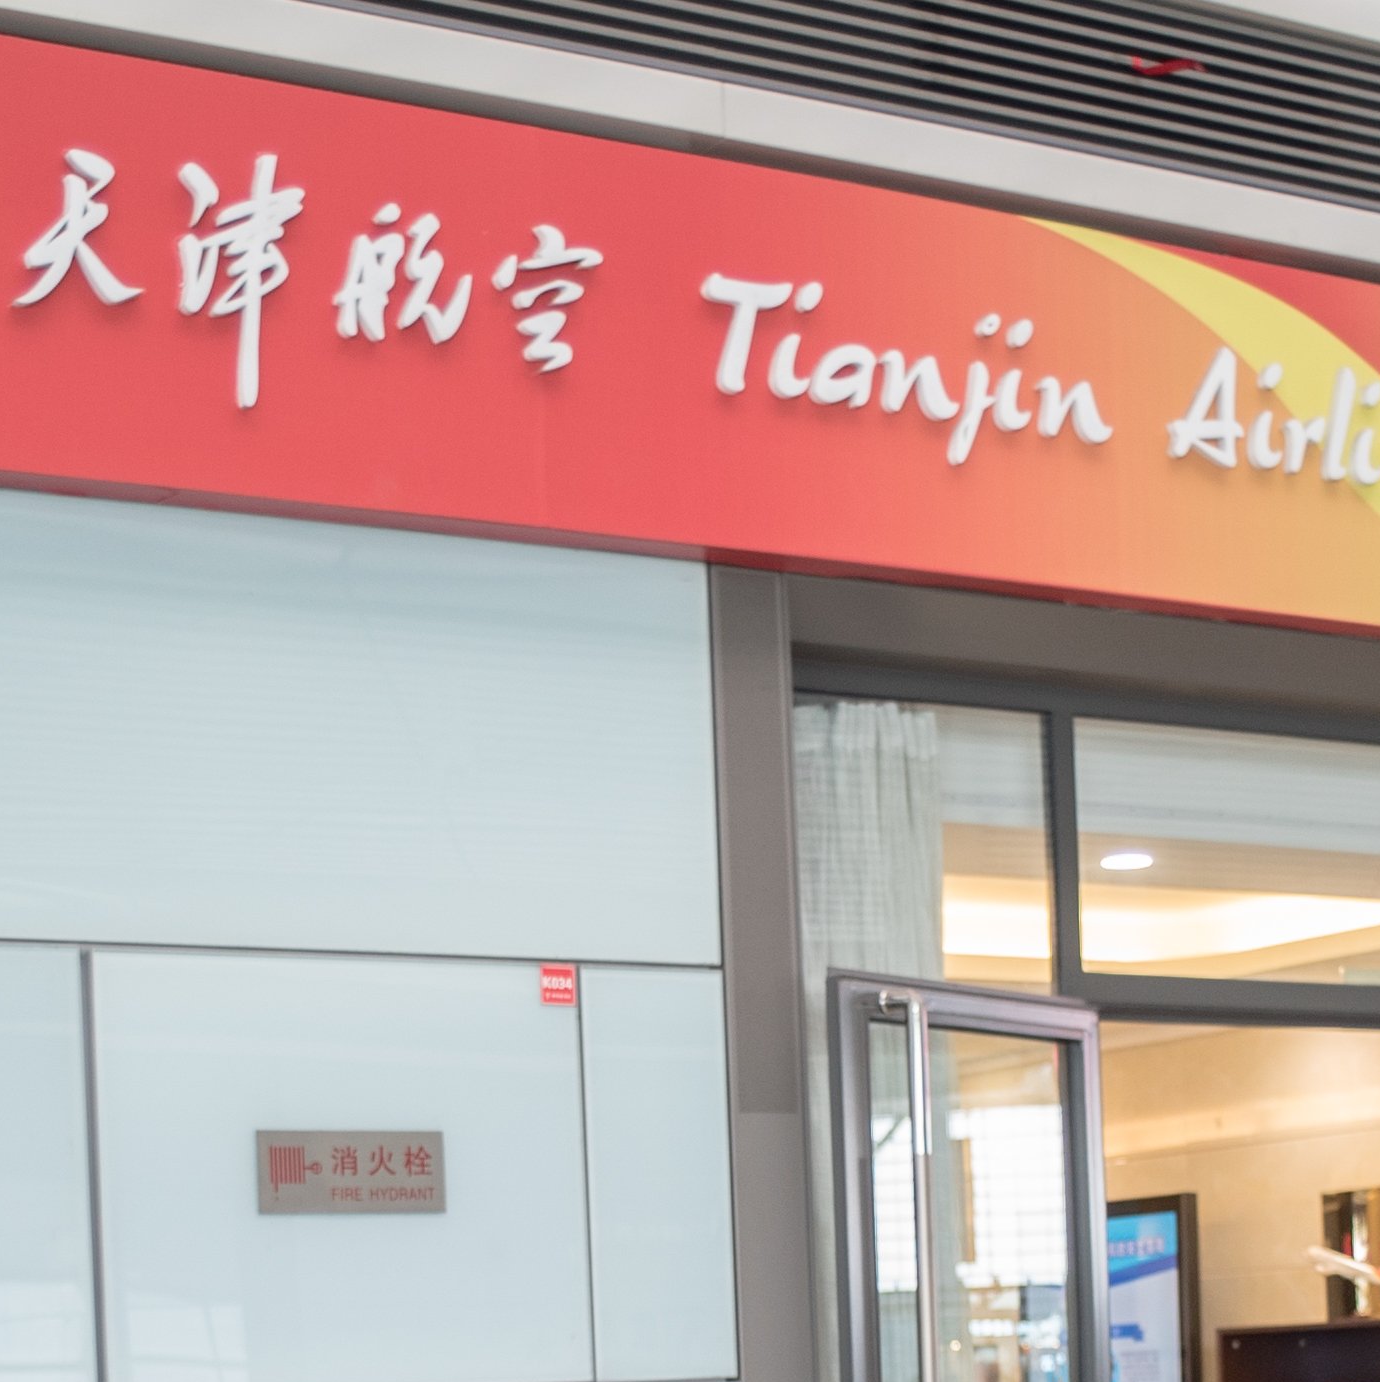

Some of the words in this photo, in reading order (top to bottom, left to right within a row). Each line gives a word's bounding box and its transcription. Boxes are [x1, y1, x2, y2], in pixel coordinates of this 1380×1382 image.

[12, 148, 603, 409] 天津航空
[701, 272, 1113, 466] Tianjin
[331, 1145, 433, 1177] 消火栓
[331, 1187, 363, 1201] FIRE
[370, 1187, 435, 1201] HYDRANT
